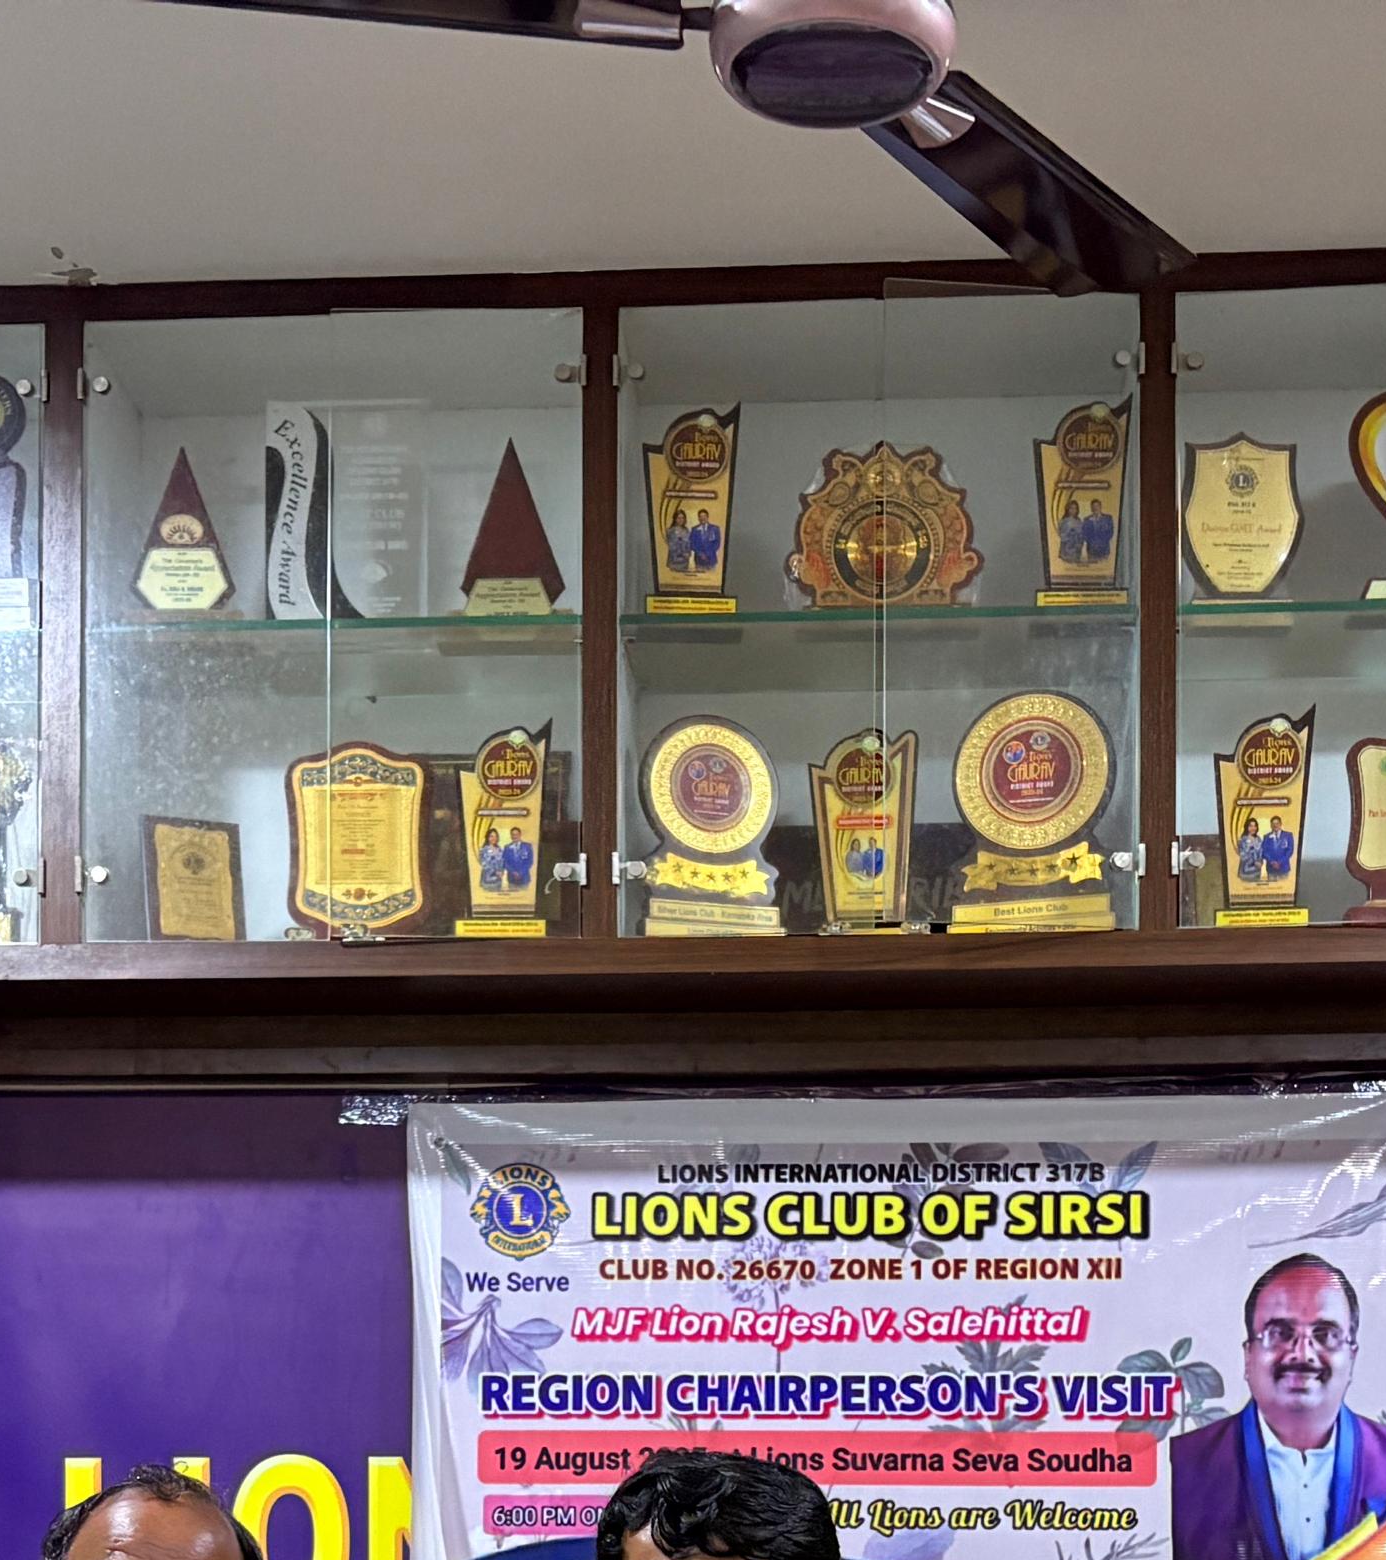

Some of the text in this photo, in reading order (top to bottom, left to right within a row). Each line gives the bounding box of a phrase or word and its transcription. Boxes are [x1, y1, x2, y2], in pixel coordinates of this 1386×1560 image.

[273, 419, 309, 606] Excellence Award
[1245, 748, 1295, 767] GAURAV
[1007, 763, 1055, 783] GAURAV
[993, 907, 1015, 917] Best
[1017, 906, 1044, 915] Lions
[658, 1163, 1105, 1184] LIONS INTERNATIONAL DISTRICT 317B
[592, 1192, 1146, 1238] LIONS CLUB OF SIRSI
[599, 1258, 1123, 1281] CLUB NO. 26670 ZONE 1 OF REGION XII
[466, 1273, 570, 1292] We Serve
[573, 1306, 1085, 1344] MJF Lion Rajesh V. Salehittal
[481, 1374, 1173, 1415] REGION CHAIRPERSON'S VISIT
[495, 1447, 527, 1471] 19
[535, 1447, 631, 1476] August
[832, 1448, 945, 1472] Suvarna
[952, 1448, 1019, 1472] Seva
[1027, 1448, 1133, 1473] Soudha
[493, 1506, 536, 1526] 6:00
[541, 1506, 575, 1526] PM
[868, 1498, 946, 1536] Lions
[949, 1505, 1000, 1530] are
[1005, 1499, 1138, 1531] Welcome
